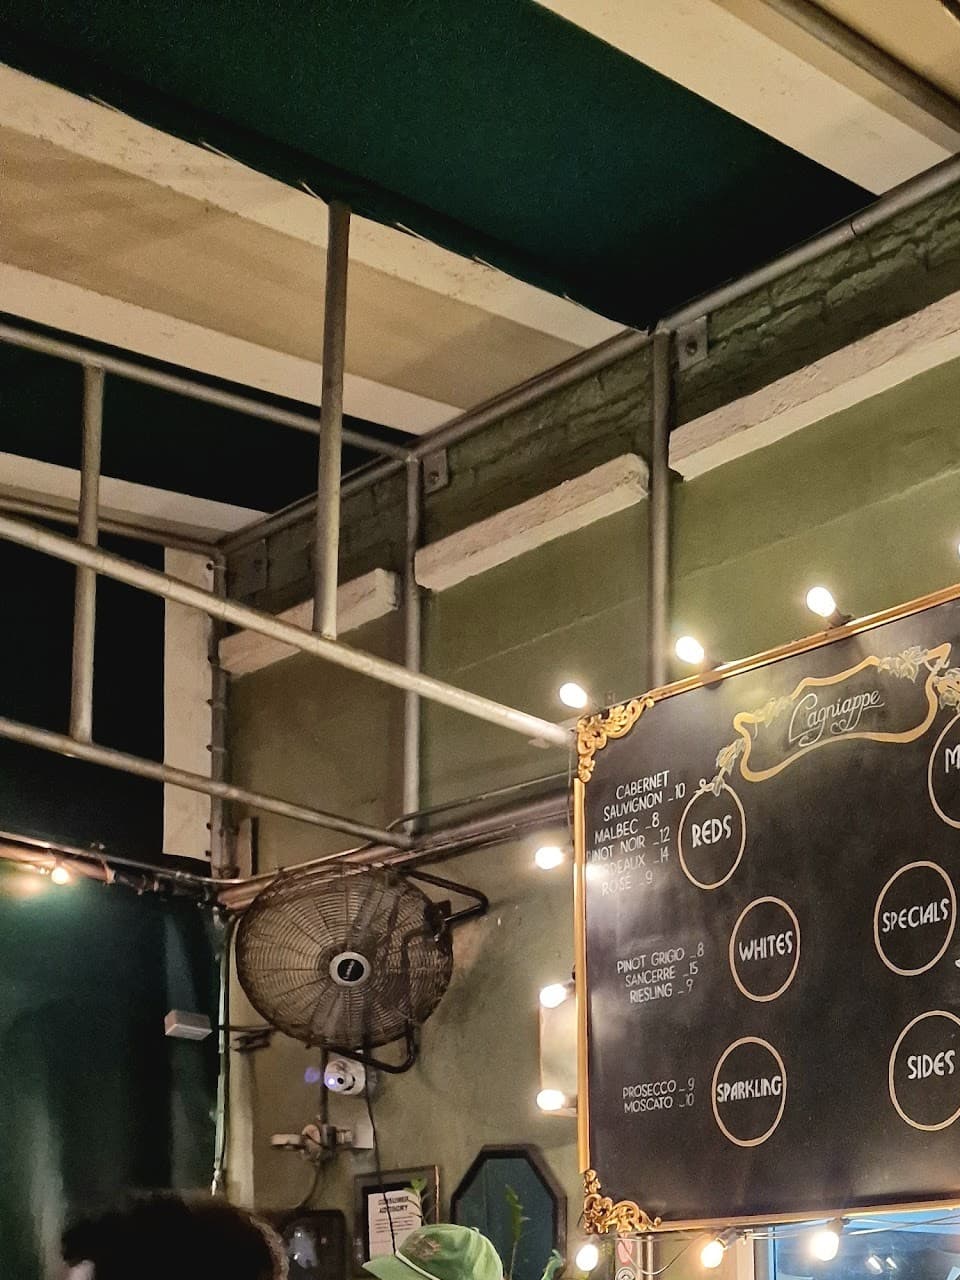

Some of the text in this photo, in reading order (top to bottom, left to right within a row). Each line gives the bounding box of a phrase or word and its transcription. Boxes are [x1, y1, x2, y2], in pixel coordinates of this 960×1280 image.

[788, 690, 885, 747] Lagniappe
[616, 770, 670, 800] CABERNET
[603, 791, 663, 822] SAUVIGNON
[594, 818, 639, 845] MALBEC
[620, 835, 646, 853] NOIR
[692, 815, 732, 849] REDS
[882, 898, 950, 934] SPECIALS
[738, 930, 793, 962] WHITES
[617, 955, 647, 974] PINOT
[651, 947, 685, 967] GRIGIO
[625, 965, 676, 988] SANCERRE
[629, 982, 673, 1004] RIESLING
[907, 1050, 956, 1080] SIDES
[622, 1079, 677, 1099] PROSECCO
[716, 1075, 783, 1103] SPARKLING
[624, 1096, 674, 1114] MOSCATO
